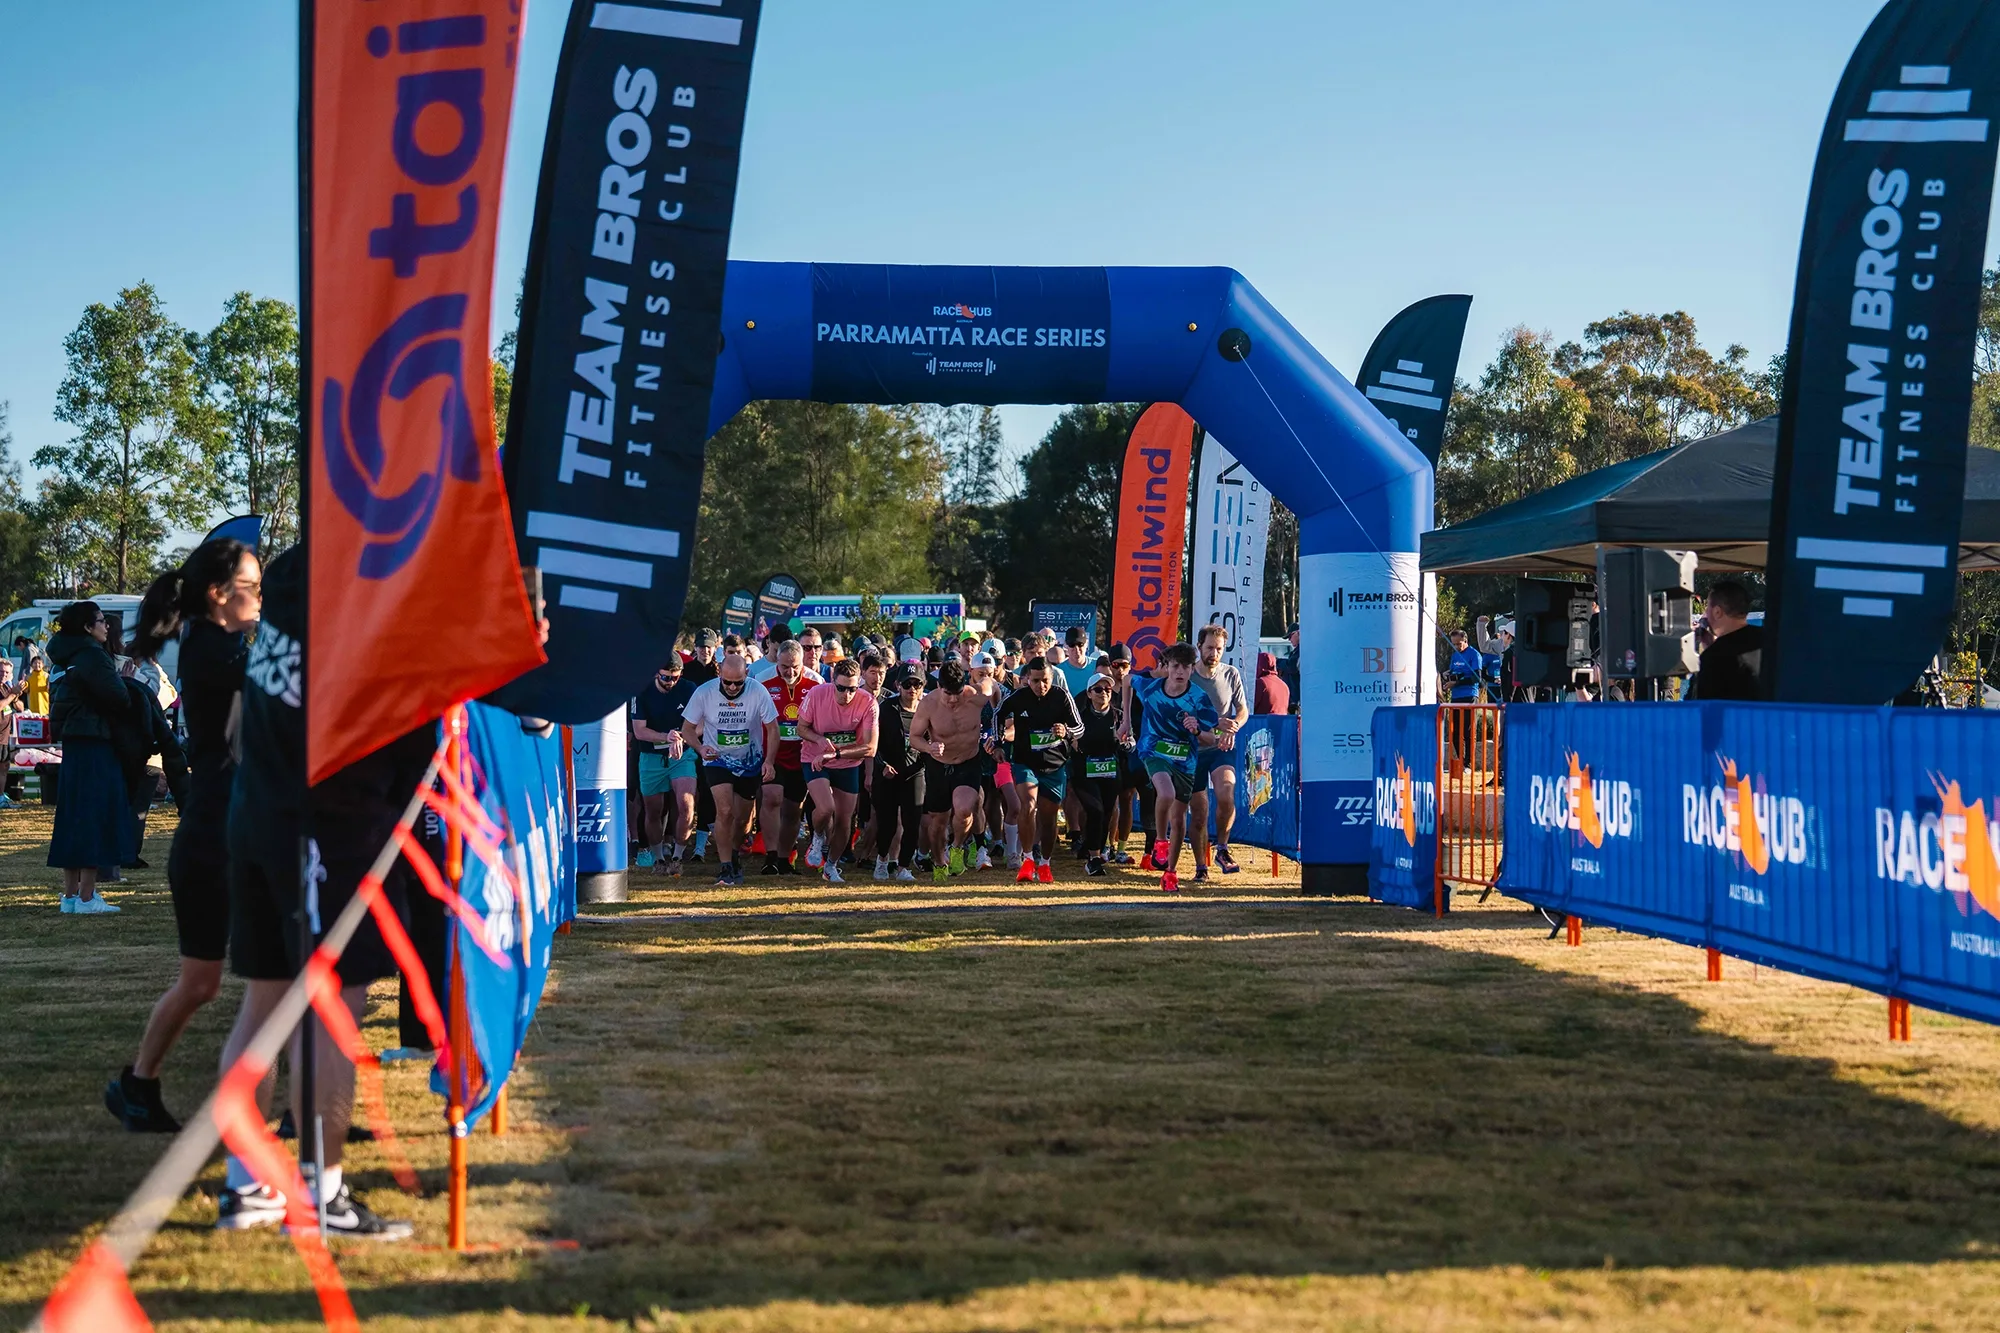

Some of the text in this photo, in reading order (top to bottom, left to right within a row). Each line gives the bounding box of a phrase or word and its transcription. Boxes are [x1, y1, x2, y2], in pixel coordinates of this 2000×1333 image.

[558, 64, 657, 484] TEAM BROS
[624, 86, 696, 488] FITNESS CLUB
[933, 306, 992, 317] RACE HUB
[817, 322, 1106, 347] PARRAMATTA RACE SERIES
[1834, 168, 1910, 515] TEAM BROS
[1895, 179, 1946, 513] FITNESS CLUB
[1131, 448, 1171, 621] tailwind
[1166, 552, 1177, 615] NUTRITION
[910, 605, 949, 616] SERVE
[1348, 593, 1415, 602] TEAM BROS
[1039, 611, 1091, 620] ESTEEM
[1360, 647, 1407, 674] BL
[1334, 680, 1389, 694] Benefit
[725, 736, 743, 744] 544
[832, 735, 850, 743] 522
[1166, 744, 1181, 755] 711
[1095, 763, 1110, 772] 561
[1376, 777, 1435, 835] RACE HUB
[1530, 775, 1633, 837] RACE HUB
[1683, 784, 1807, 865] RACE HUB
[1875, 807, 1970, 892] RACE
